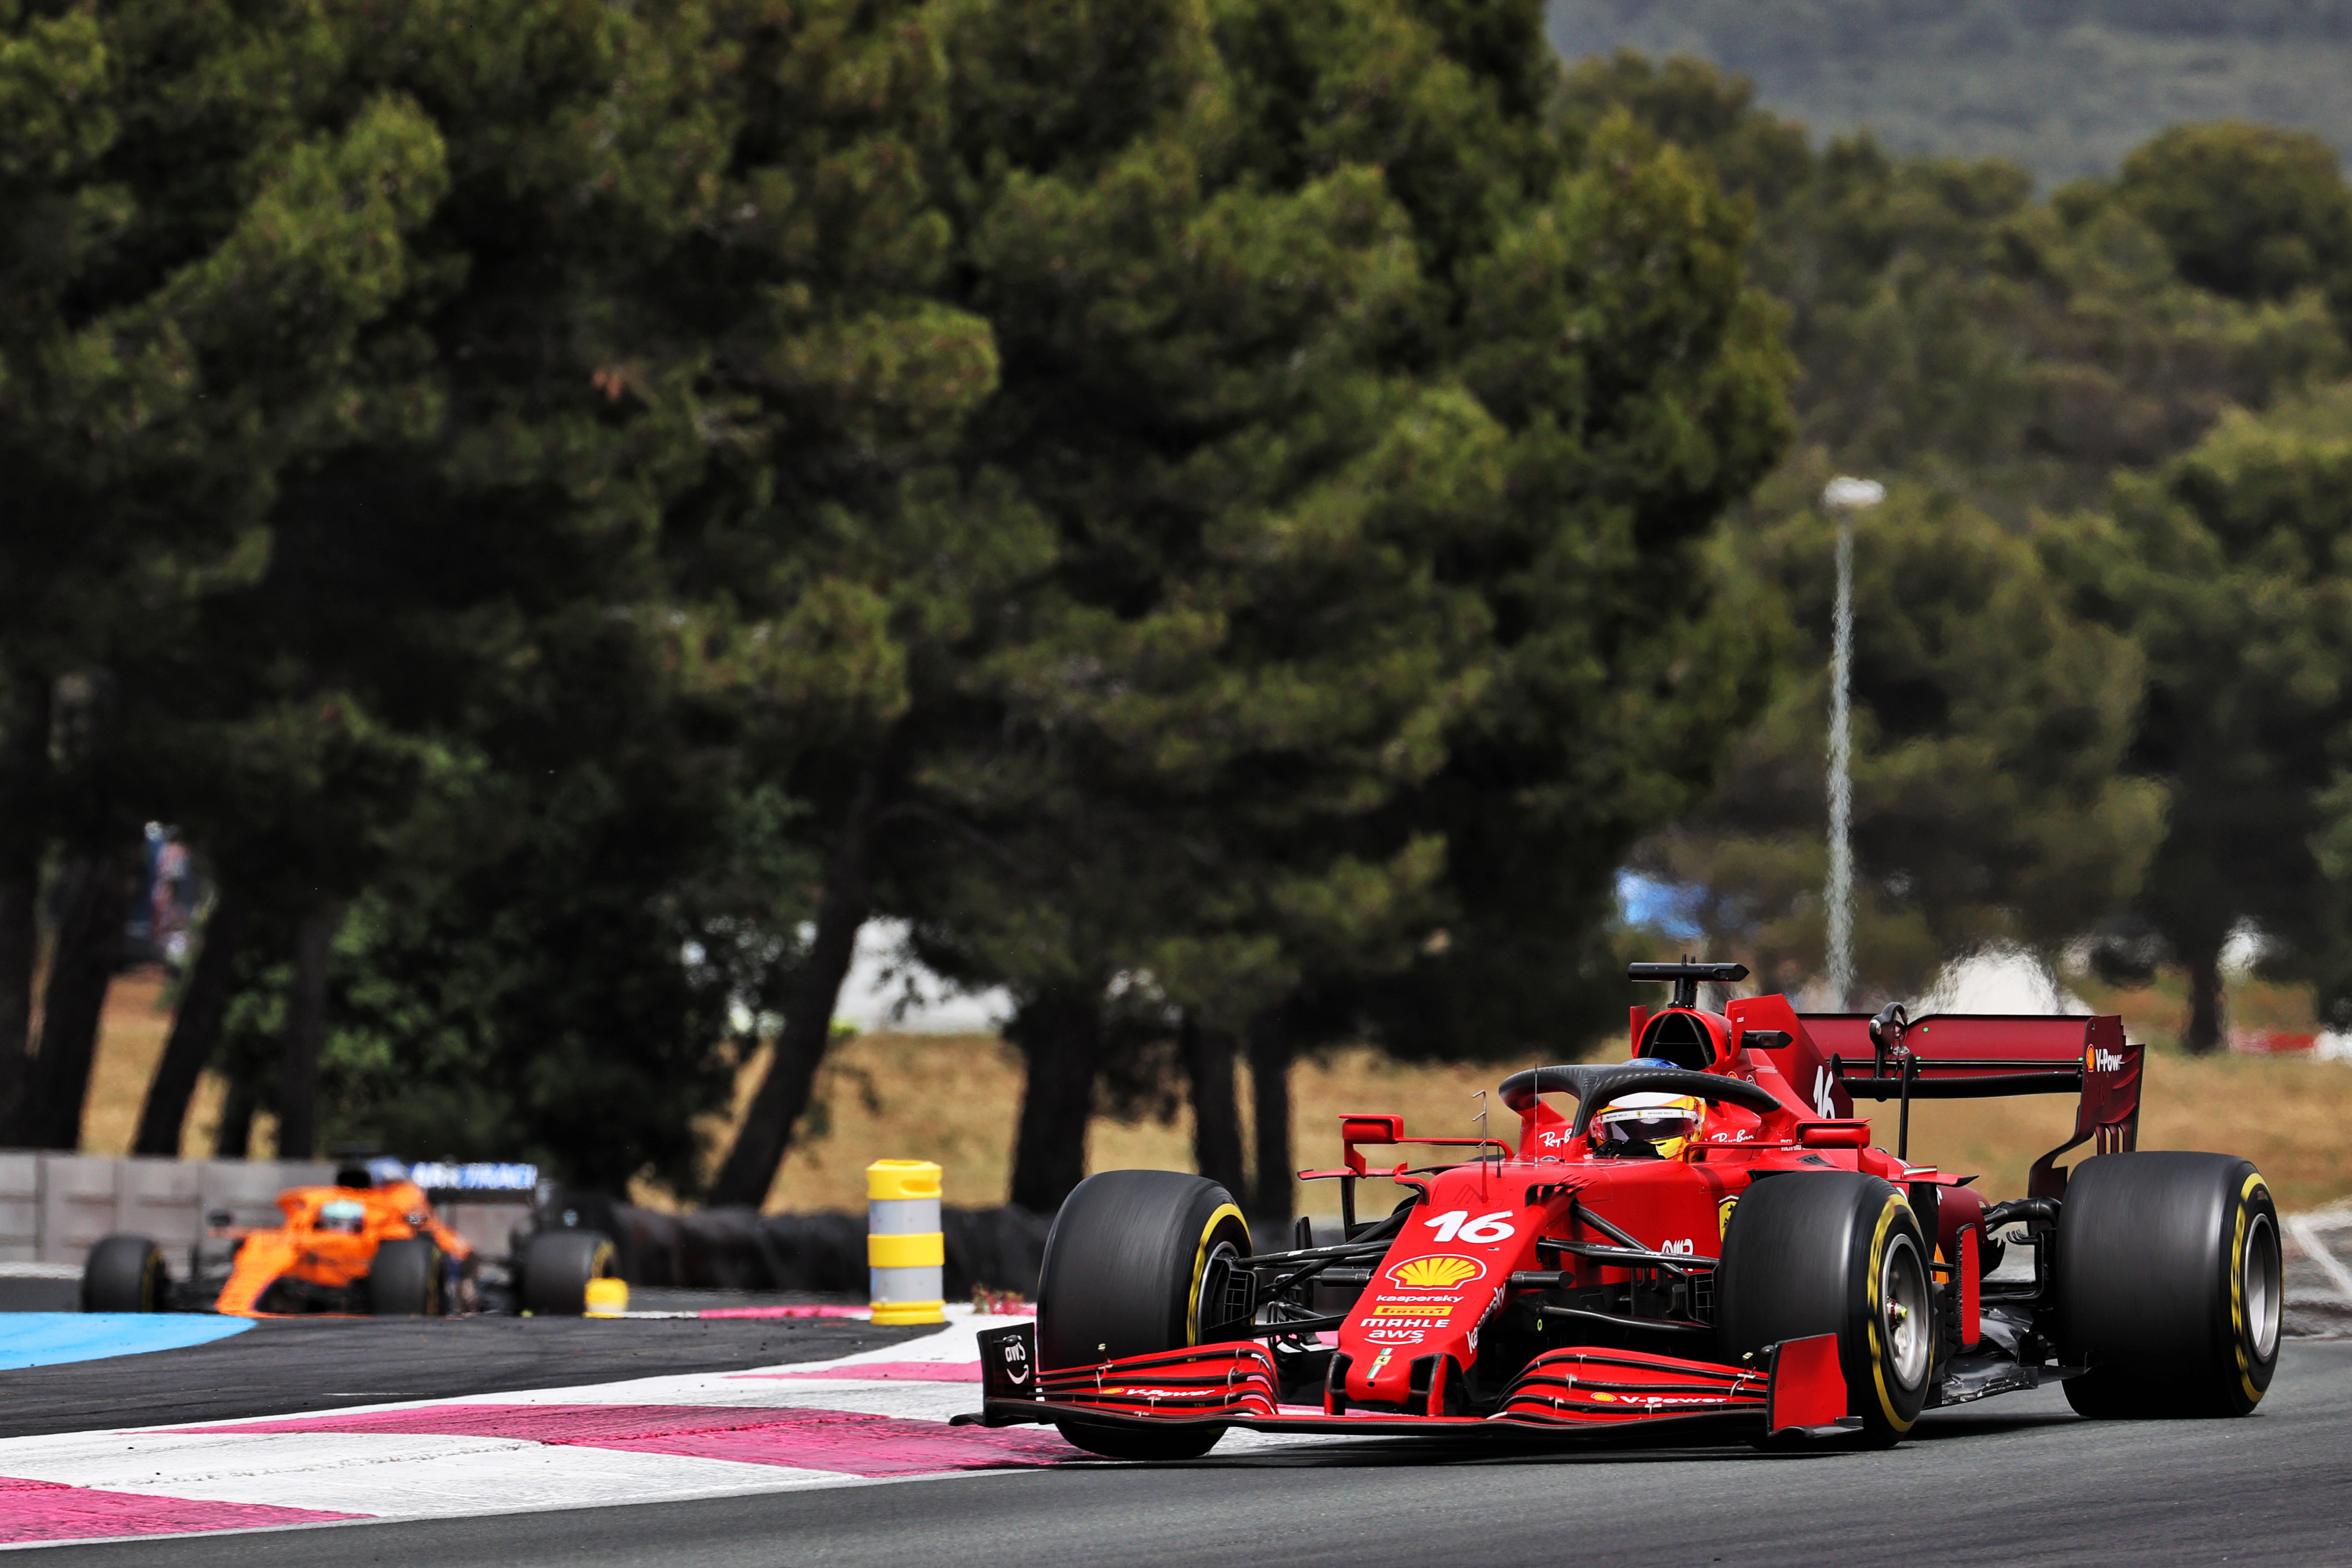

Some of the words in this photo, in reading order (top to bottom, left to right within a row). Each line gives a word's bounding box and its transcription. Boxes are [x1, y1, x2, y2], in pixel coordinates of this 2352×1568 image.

[1813, 1065, 1835, 1119] 16
[1424, 1210, 1515, 1243] 16
[1376, 1295, 1464, 1303] kaspersky
[1360, 1318, 1451, 1327] MAHLE
[1369, 1329, 1426, 1339] aws
